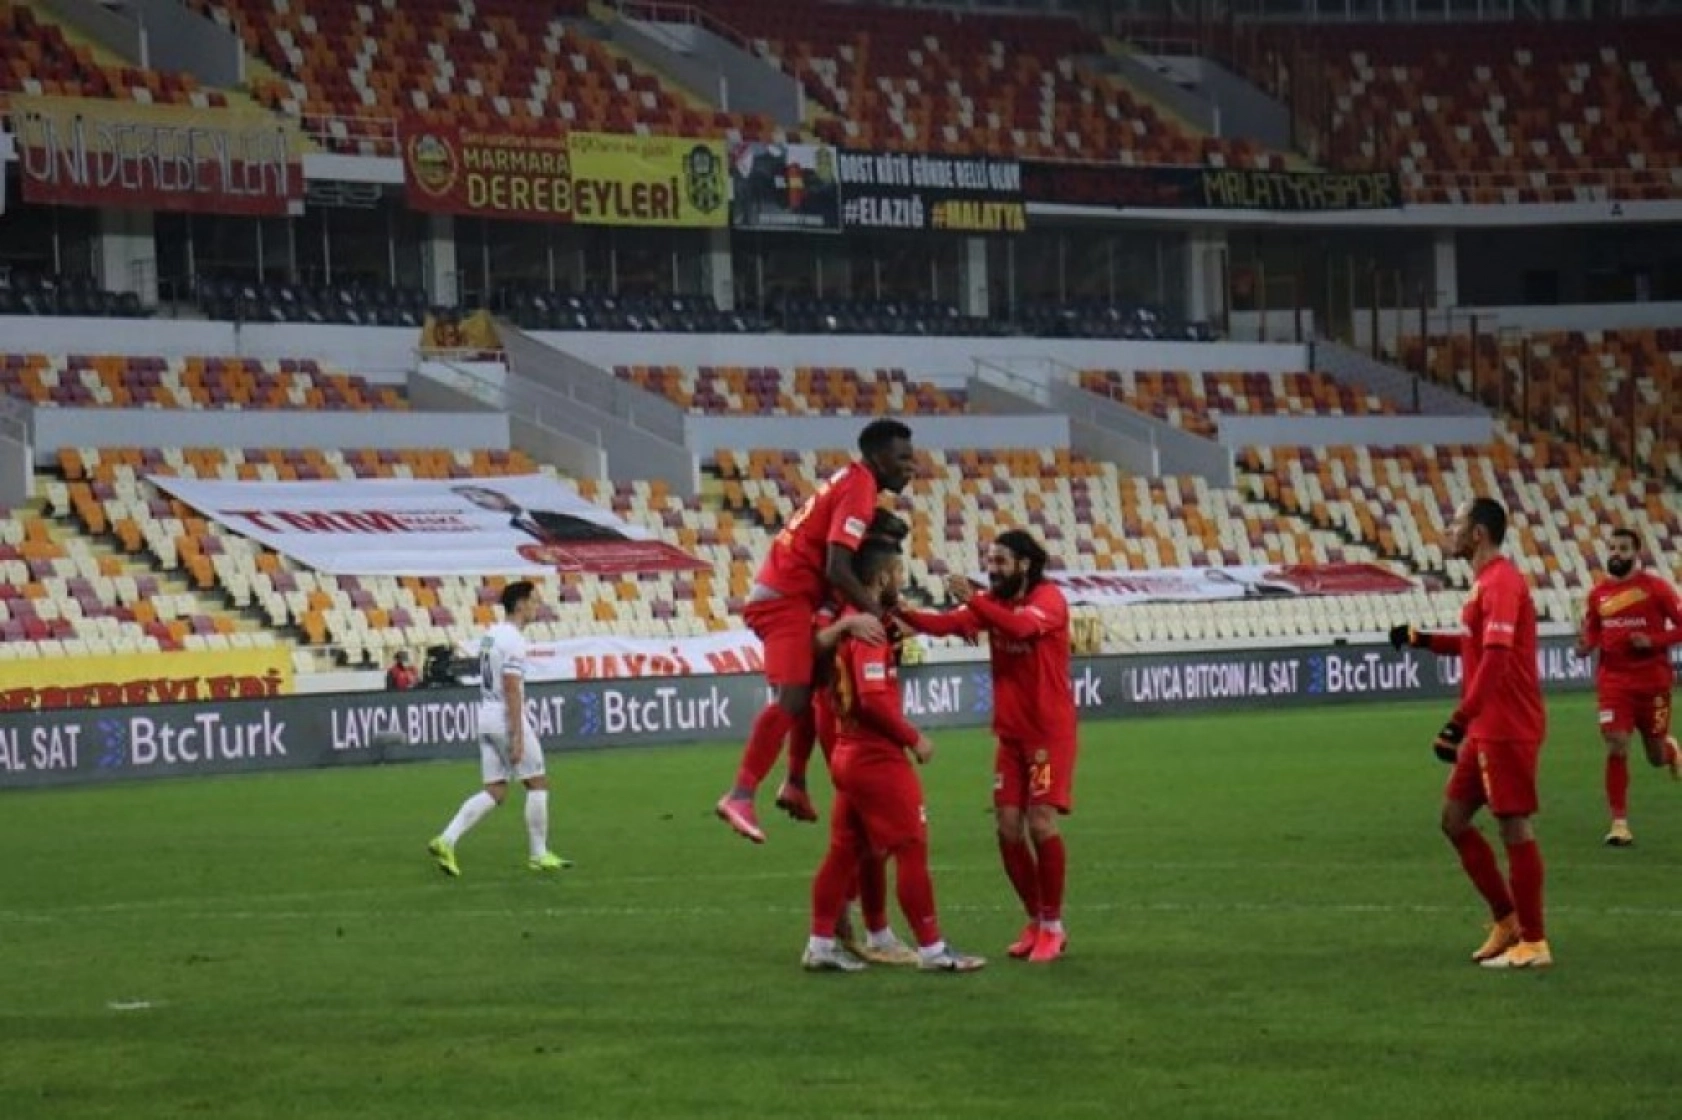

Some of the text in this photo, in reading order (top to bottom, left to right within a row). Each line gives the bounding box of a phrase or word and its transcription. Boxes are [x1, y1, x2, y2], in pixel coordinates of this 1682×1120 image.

[463, 146, 568, 175] MARMARA
[467, 173, 679, 220] DEREBEYLERİ
[1203, 172, 1393, 208] MALATYASPOR
[844, 193, 1026, 232] #ELAZIĞ #MALATYA
[1185, 662, 1245, 699] BITCOIN
[1248, 660, 1267, 695] AL
[1268, 659, 1299, 693] SAT
[1325, 652, 1421, 693] BtcTurk
[604, 686, 731, 735] BtcTurk
[902, 676, 962, 715] AL SAT
[31, 724, 80, 769] SAT
[130, 708, 287, 766] BtcTurk
